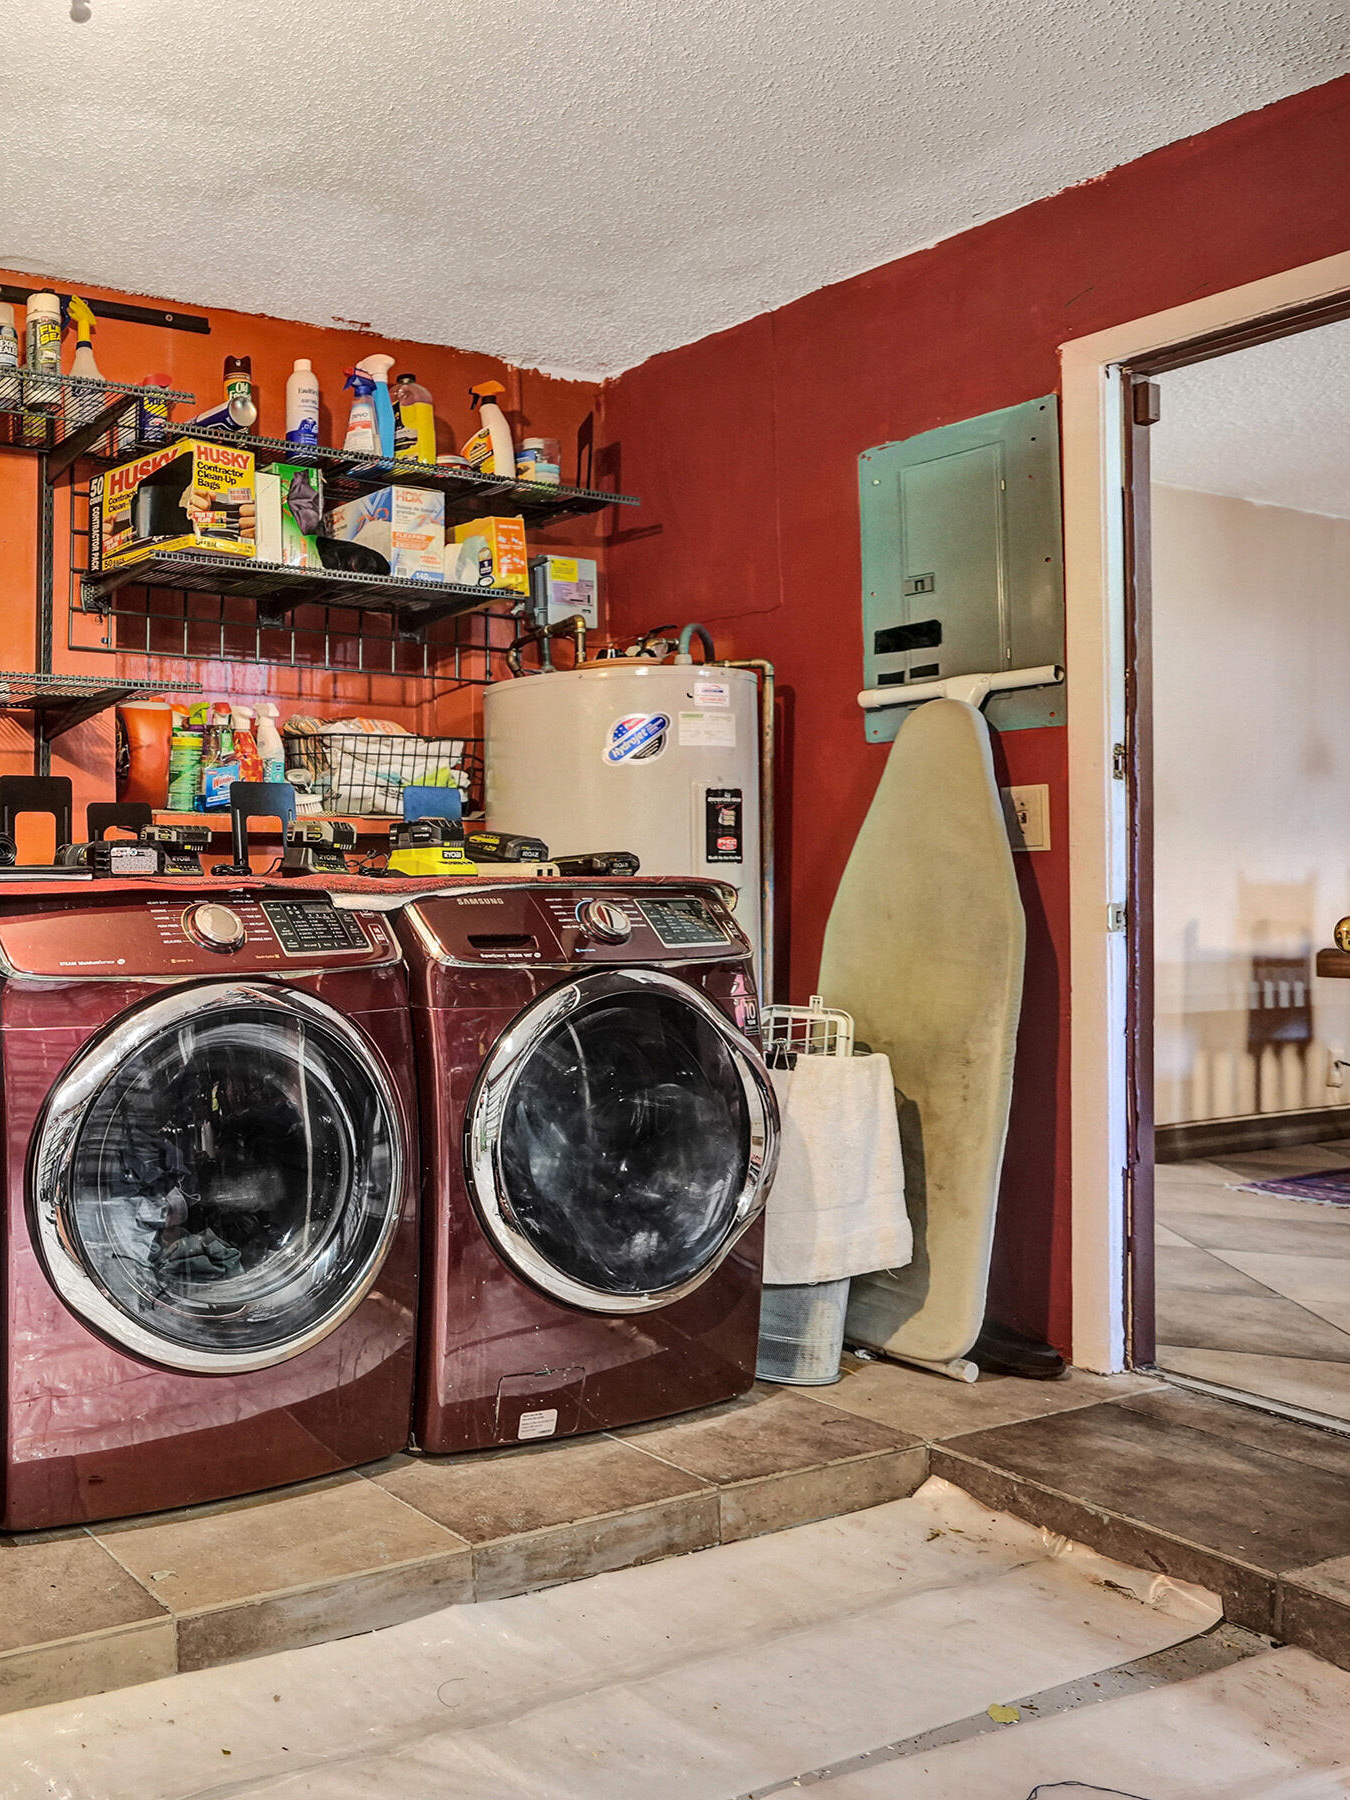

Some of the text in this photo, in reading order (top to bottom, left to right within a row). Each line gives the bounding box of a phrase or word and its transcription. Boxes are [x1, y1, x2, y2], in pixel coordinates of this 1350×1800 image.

[196, 445, 250, 470] HUSKY
[196, 461, 244, 478] Contractor
[196, 469, 237, 486] Clean-Up
[90, 475, 104, 498] 50
[197, 478, 221, 491] Bags
[396, 490, 424, 504] HDX
[91, 506, 100, 572] CONTRACTOR PACK
[612, 728, 649, 758] Hydrojet
[443, 851, 462, 859] RYOBI
